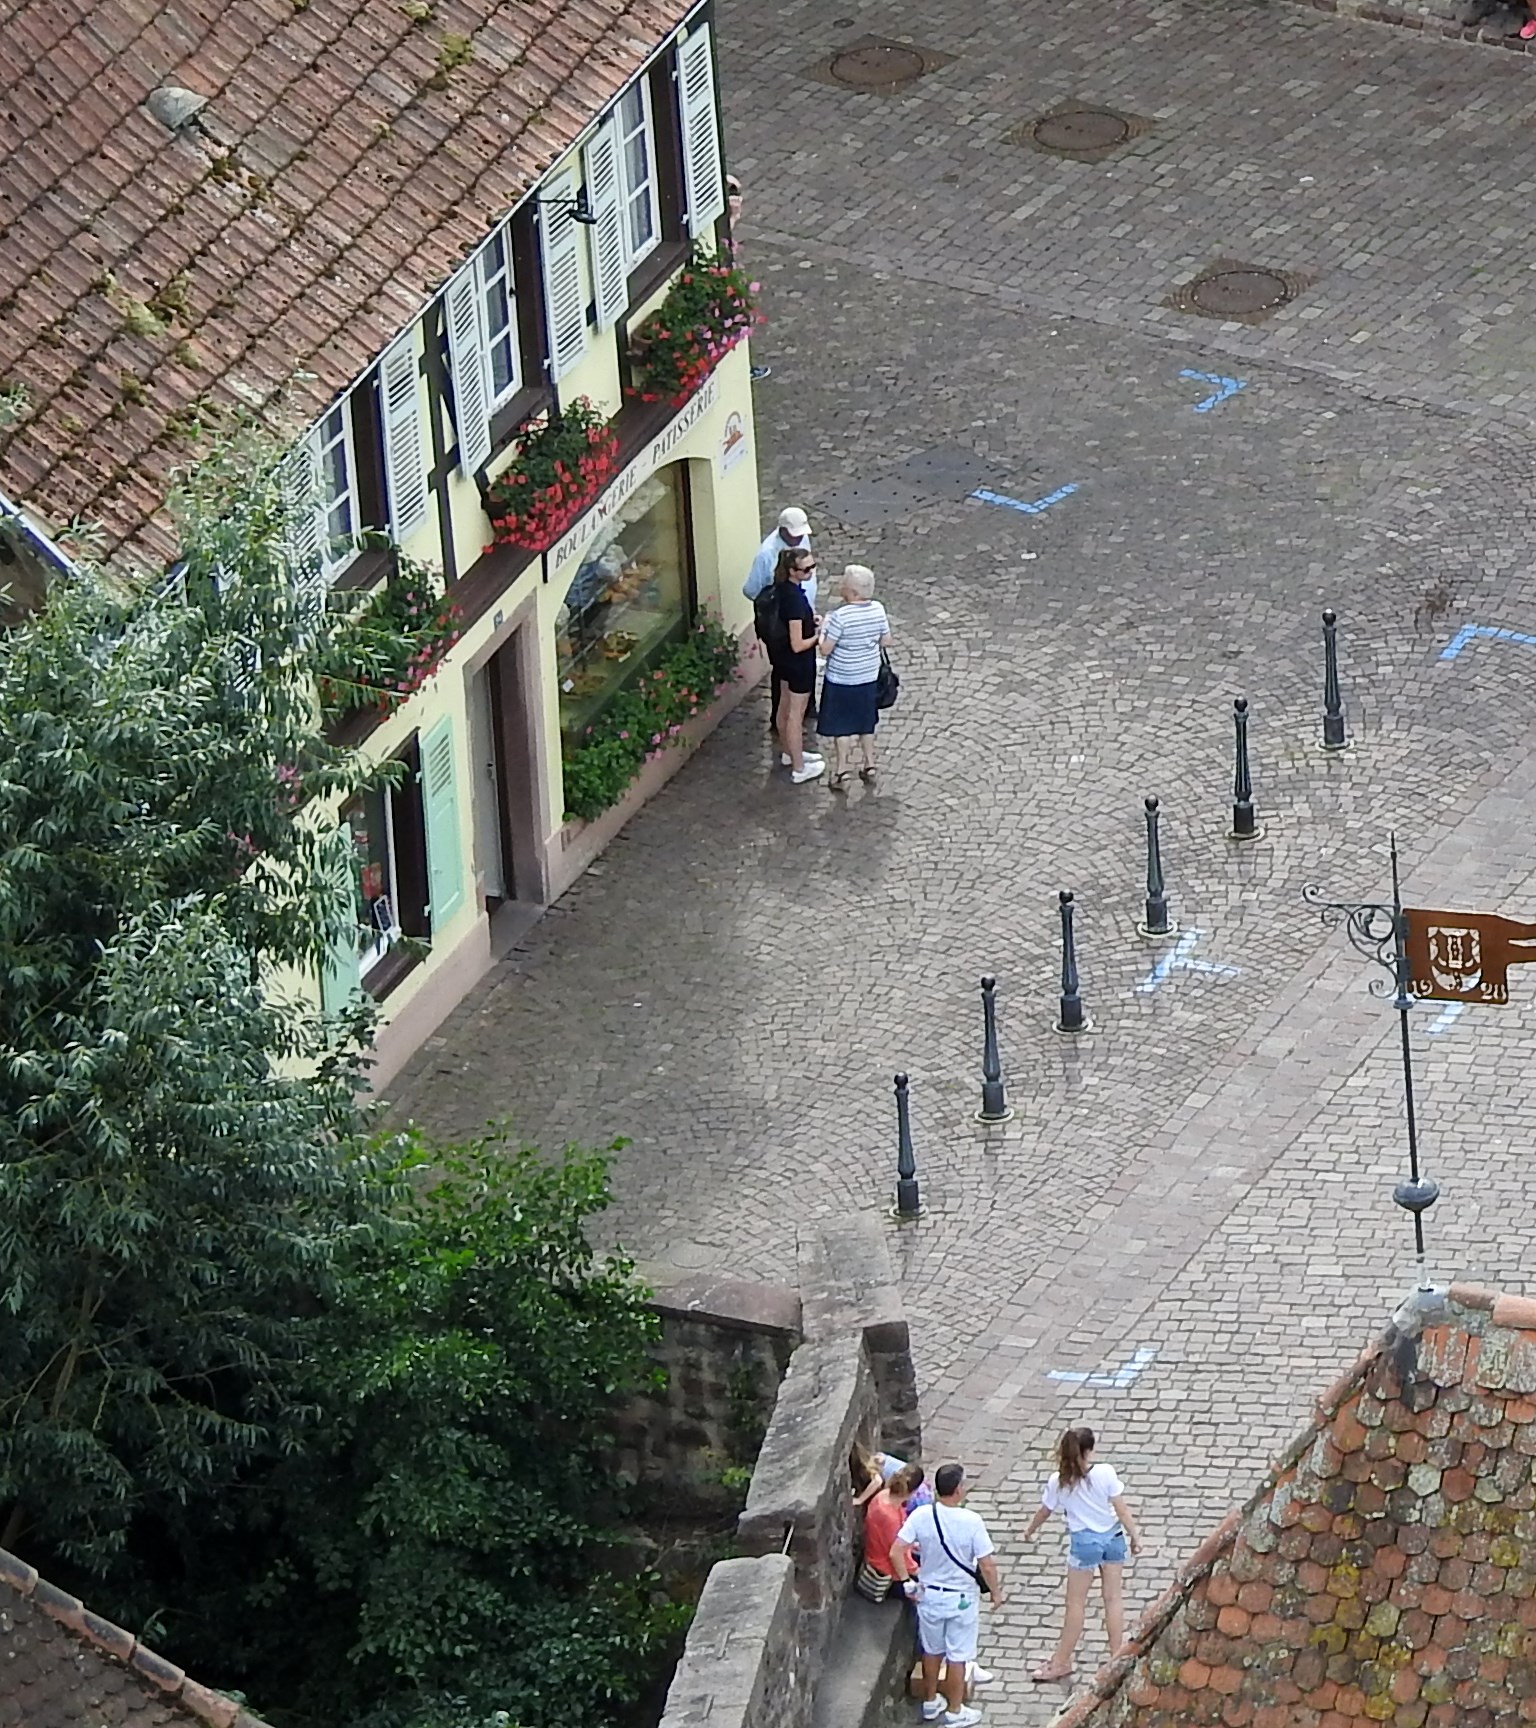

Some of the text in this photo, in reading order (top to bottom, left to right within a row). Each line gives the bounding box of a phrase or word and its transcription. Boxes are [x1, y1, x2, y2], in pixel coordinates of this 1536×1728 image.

[556, 465, 637, 569] BOULANGERIE
[653, 381, 714, 465] PATISSERIE
[1412, 979, 1433, 997] 19
